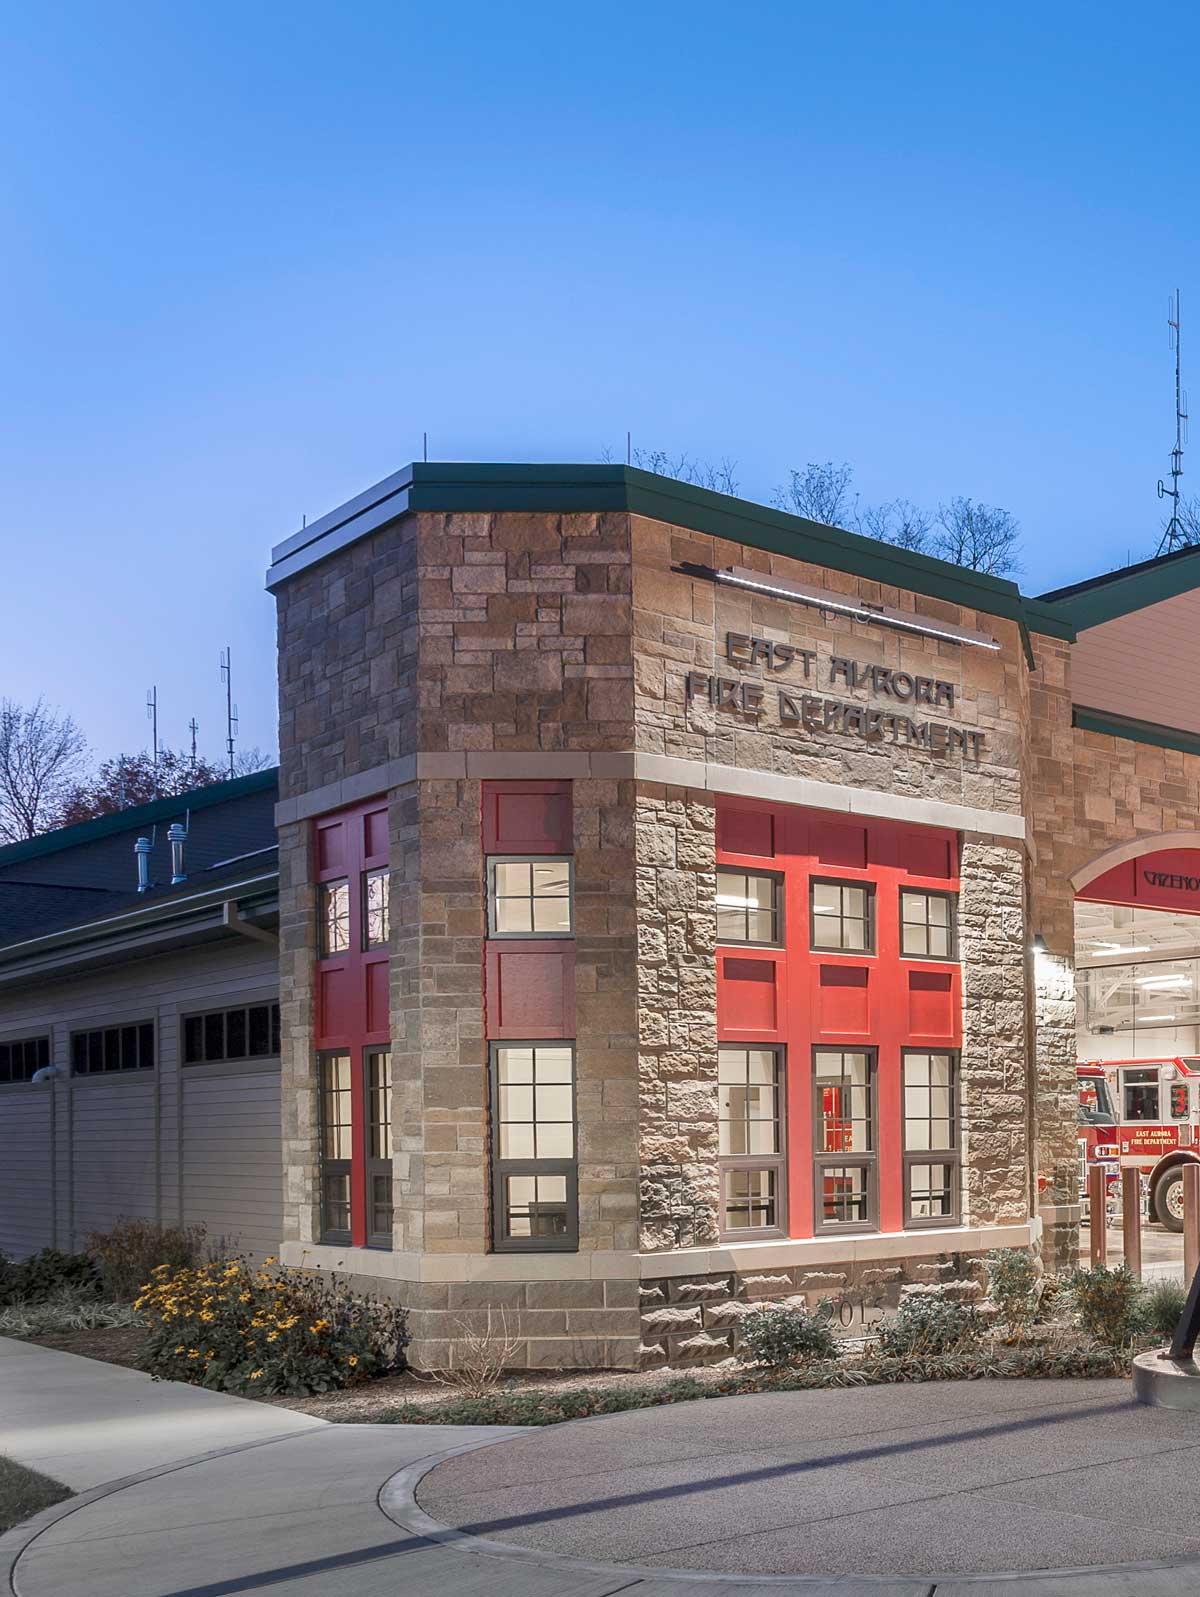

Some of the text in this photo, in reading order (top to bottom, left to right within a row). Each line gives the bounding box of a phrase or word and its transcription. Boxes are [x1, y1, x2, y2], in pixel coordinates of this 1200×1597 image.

[727, 632, 954, 708] EAST AURORA
[687, 671, 985, 754] FIRE DEPARTMENT
[1175, 1089, 1186, 1114] 3
